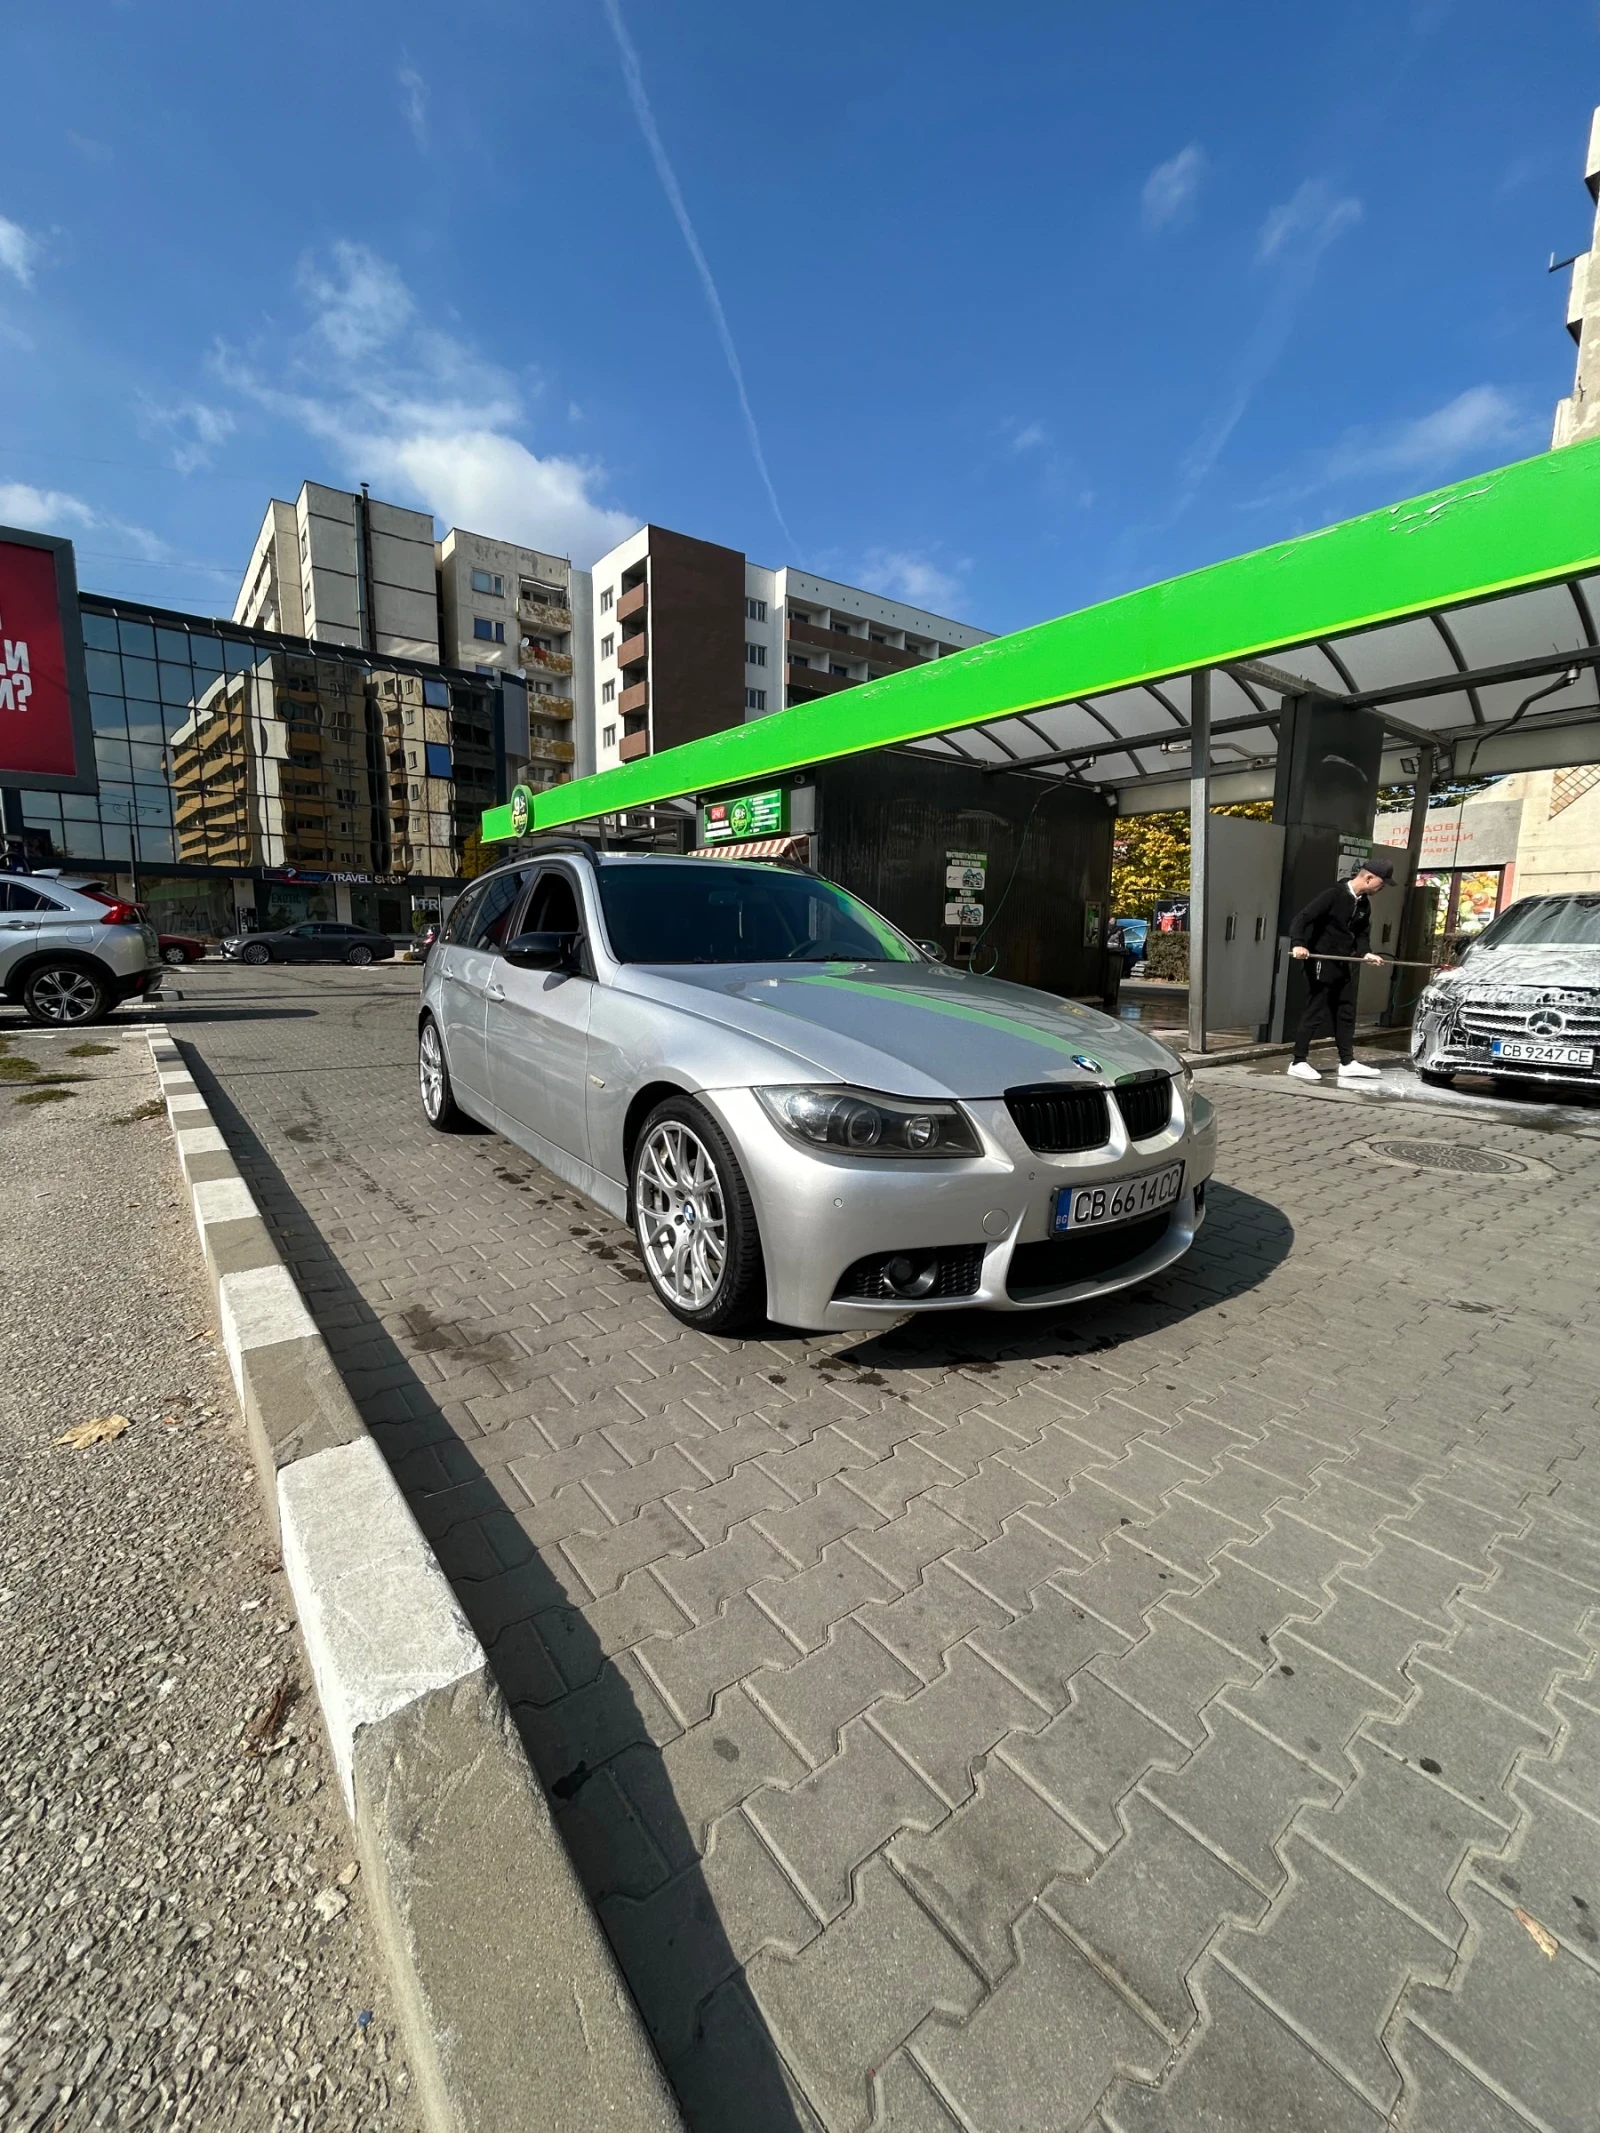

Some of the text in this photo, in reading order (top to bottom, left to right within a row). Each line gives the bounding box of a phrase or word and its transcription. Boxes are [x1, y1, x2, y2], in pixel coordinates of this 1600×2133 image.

[1392, 821, 1464, 835] ПЛДОВЕ
[1382, 833, 1474, 846] ЗЕЛНЧУЦИ
[332, 872, 372, 884] TRAVEL
[374, 875, 406, 885] SHOP
[271, 893, 301, 904] EXOTIC
[1502, 1044, 1590, 1063] CB 9247 CE
[1073, 1169, 1179, 1223] CB 6614 CC
[1056, 1215, 1067, 1225] BG
